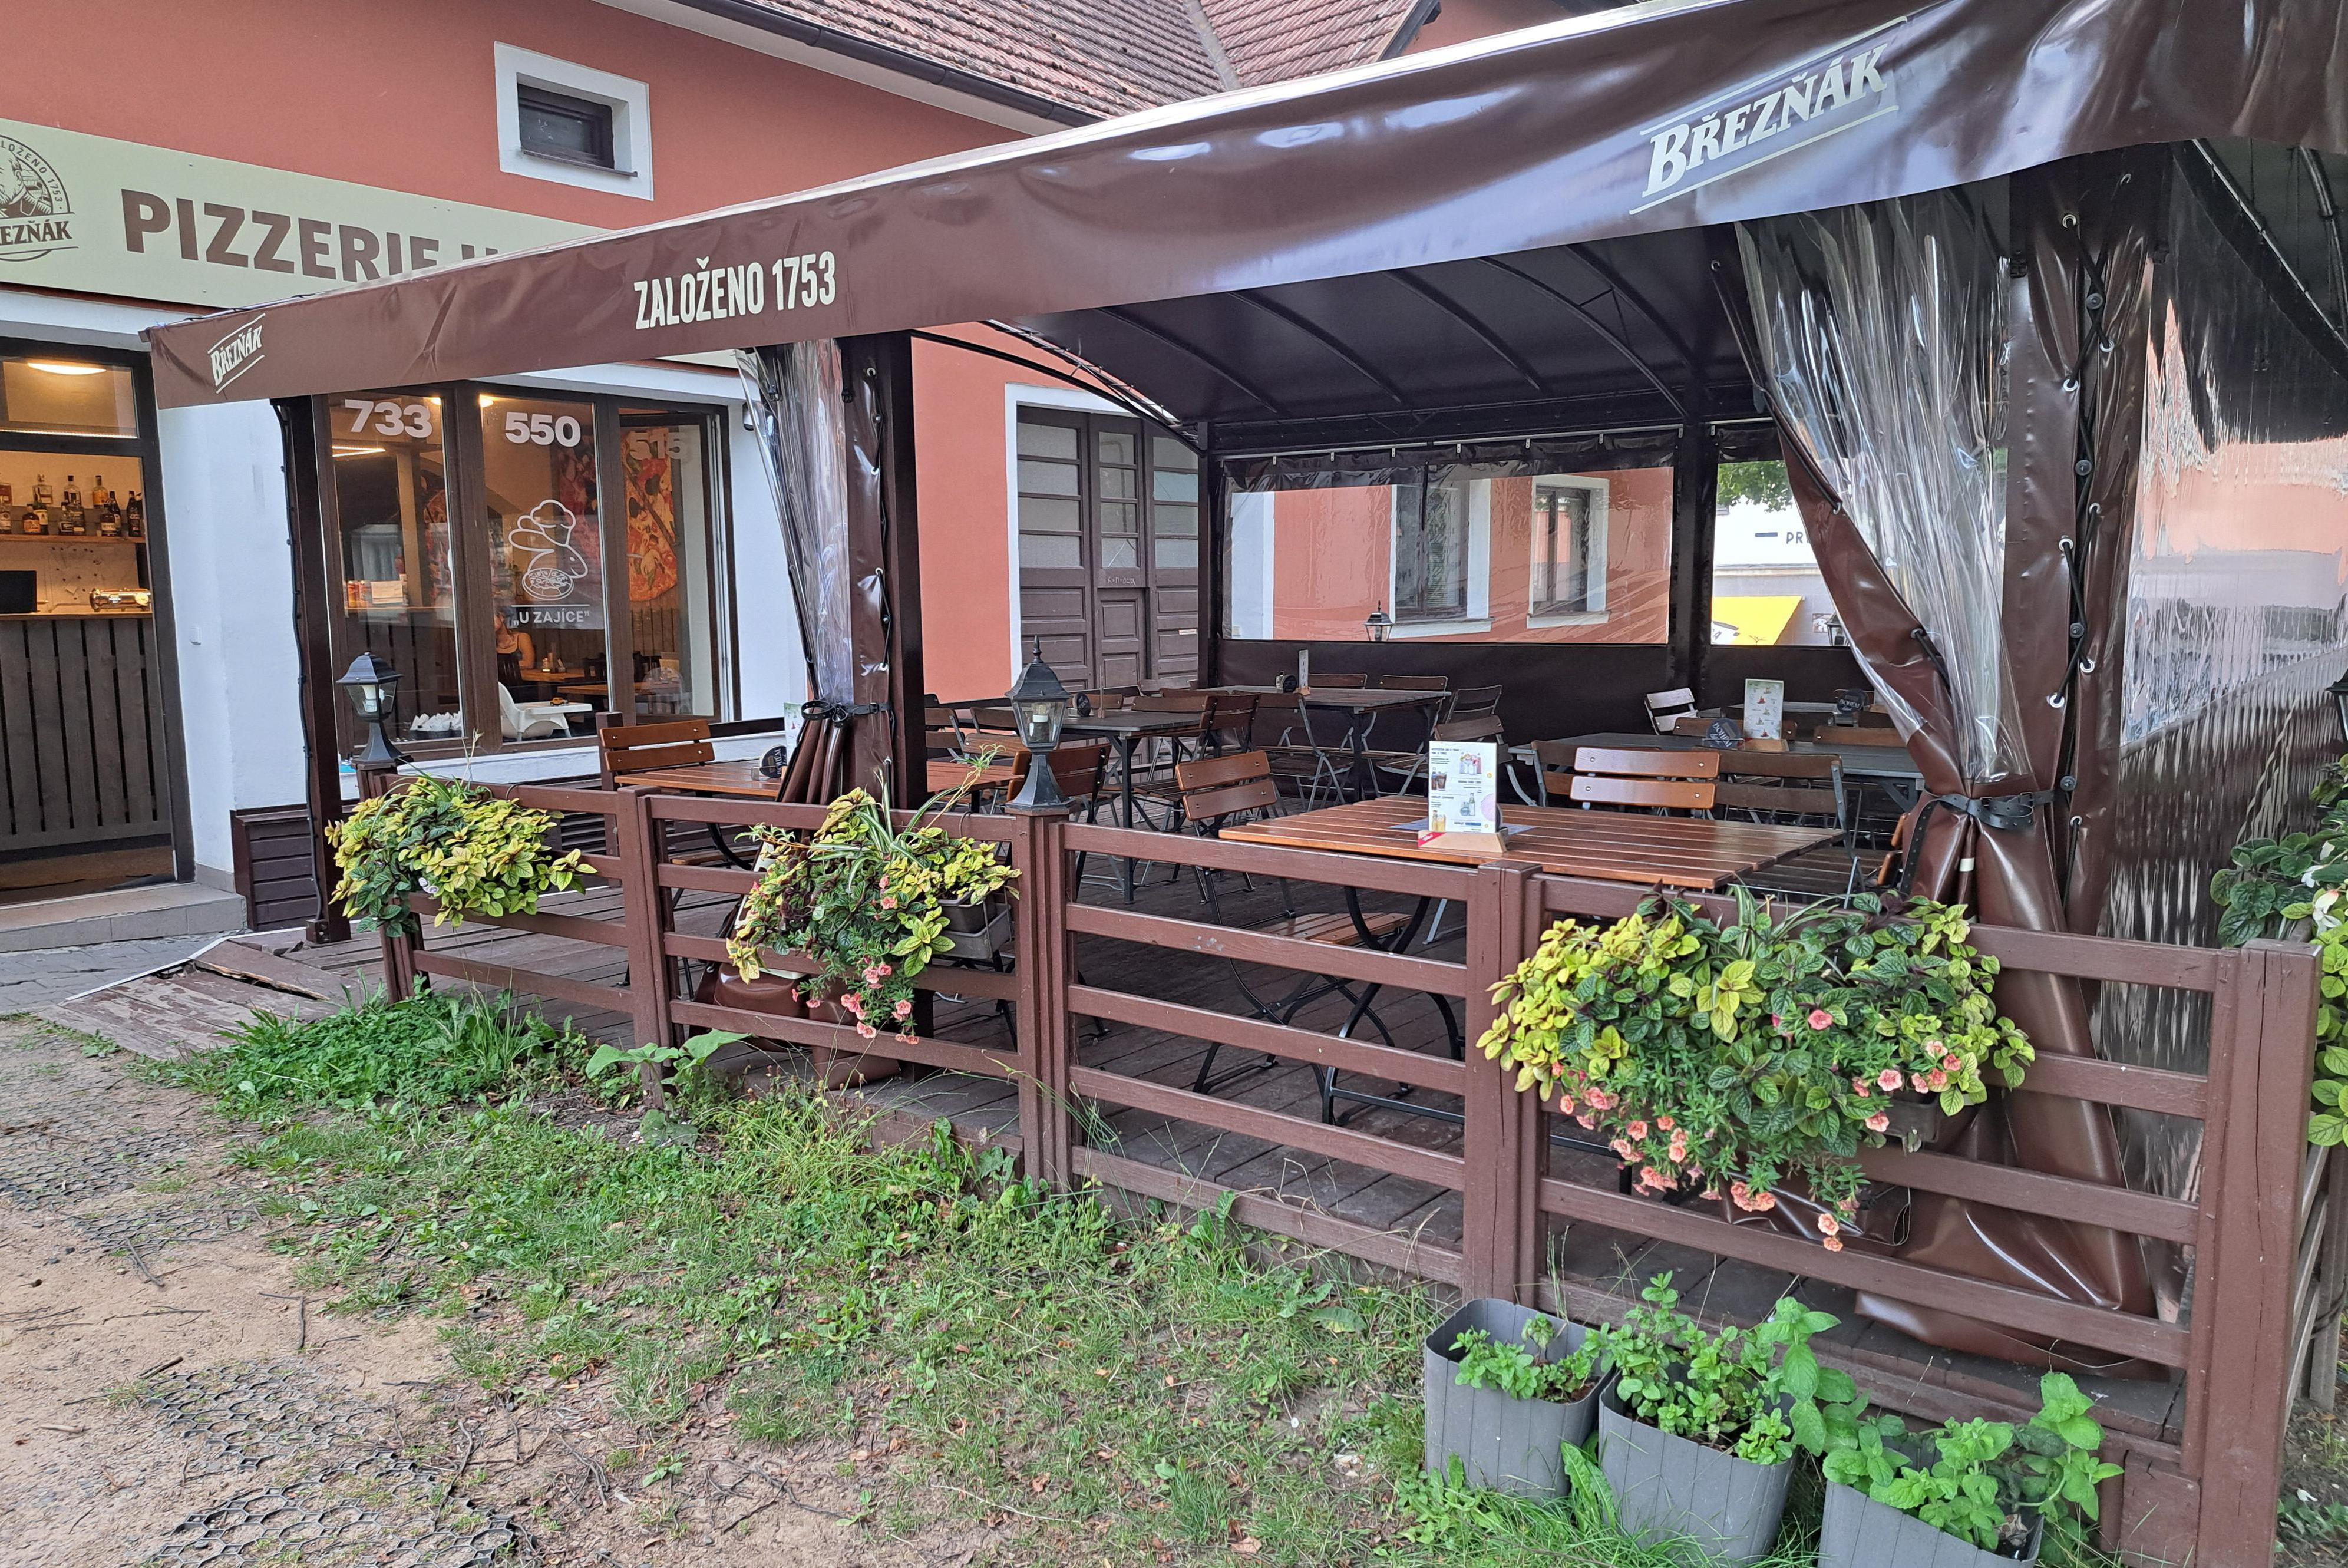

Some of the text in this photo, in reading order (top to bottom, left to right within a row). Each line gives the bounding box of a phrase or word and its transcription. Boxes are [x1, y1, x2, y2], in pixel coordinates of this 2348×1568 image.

[1642, 43, 1887, 198] BŘEZŇÁK
[47, 178, 63, 202] 1753
[121, 189, 439, 283] PIZZERIE
[634, 250, 837, 329] ZALOŽENO 1753
[210, 325, 263, 387] BŘEZŇÁK
[344, 399, 433, 438] 733
[505, 412, 581, 448] 550
